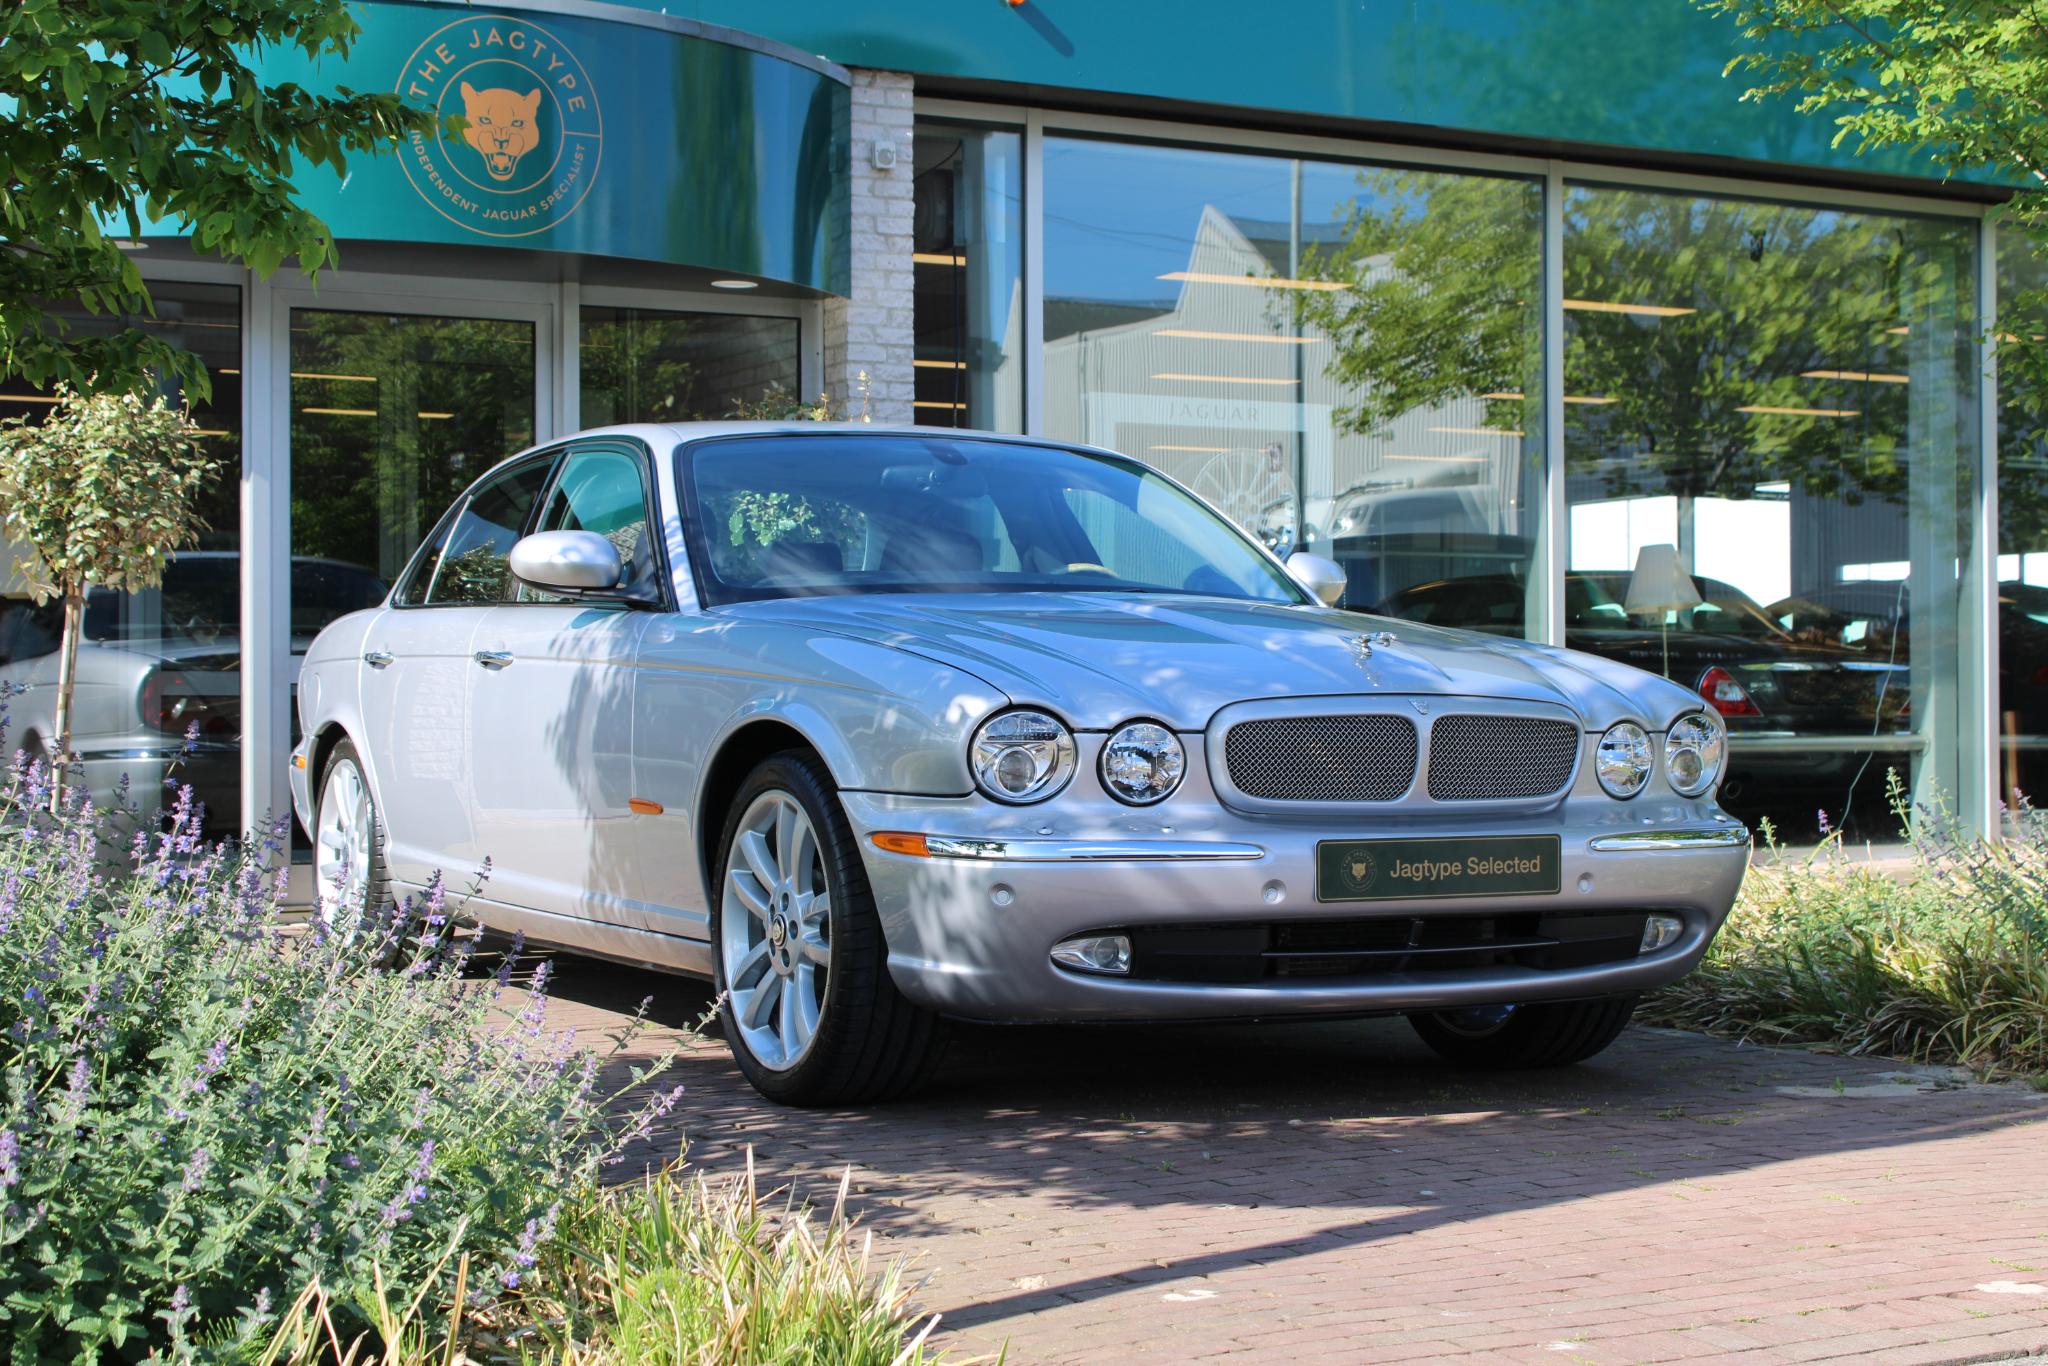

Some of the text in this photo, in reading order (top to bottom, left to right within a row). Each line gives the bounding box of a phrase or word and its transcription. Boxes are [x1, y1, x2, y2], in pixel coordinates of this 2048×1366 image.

[408, 27, 586, 113] THE JAGTYPE
[410, 129, 585, 221] INDEPENDENT JAGUAR SPECIALIST
[1169, 402, 1259, 422] JAGUAR
[1390, 859, 1462, 881] Jagtype
[1467, 856, 1541, 876] Selected
